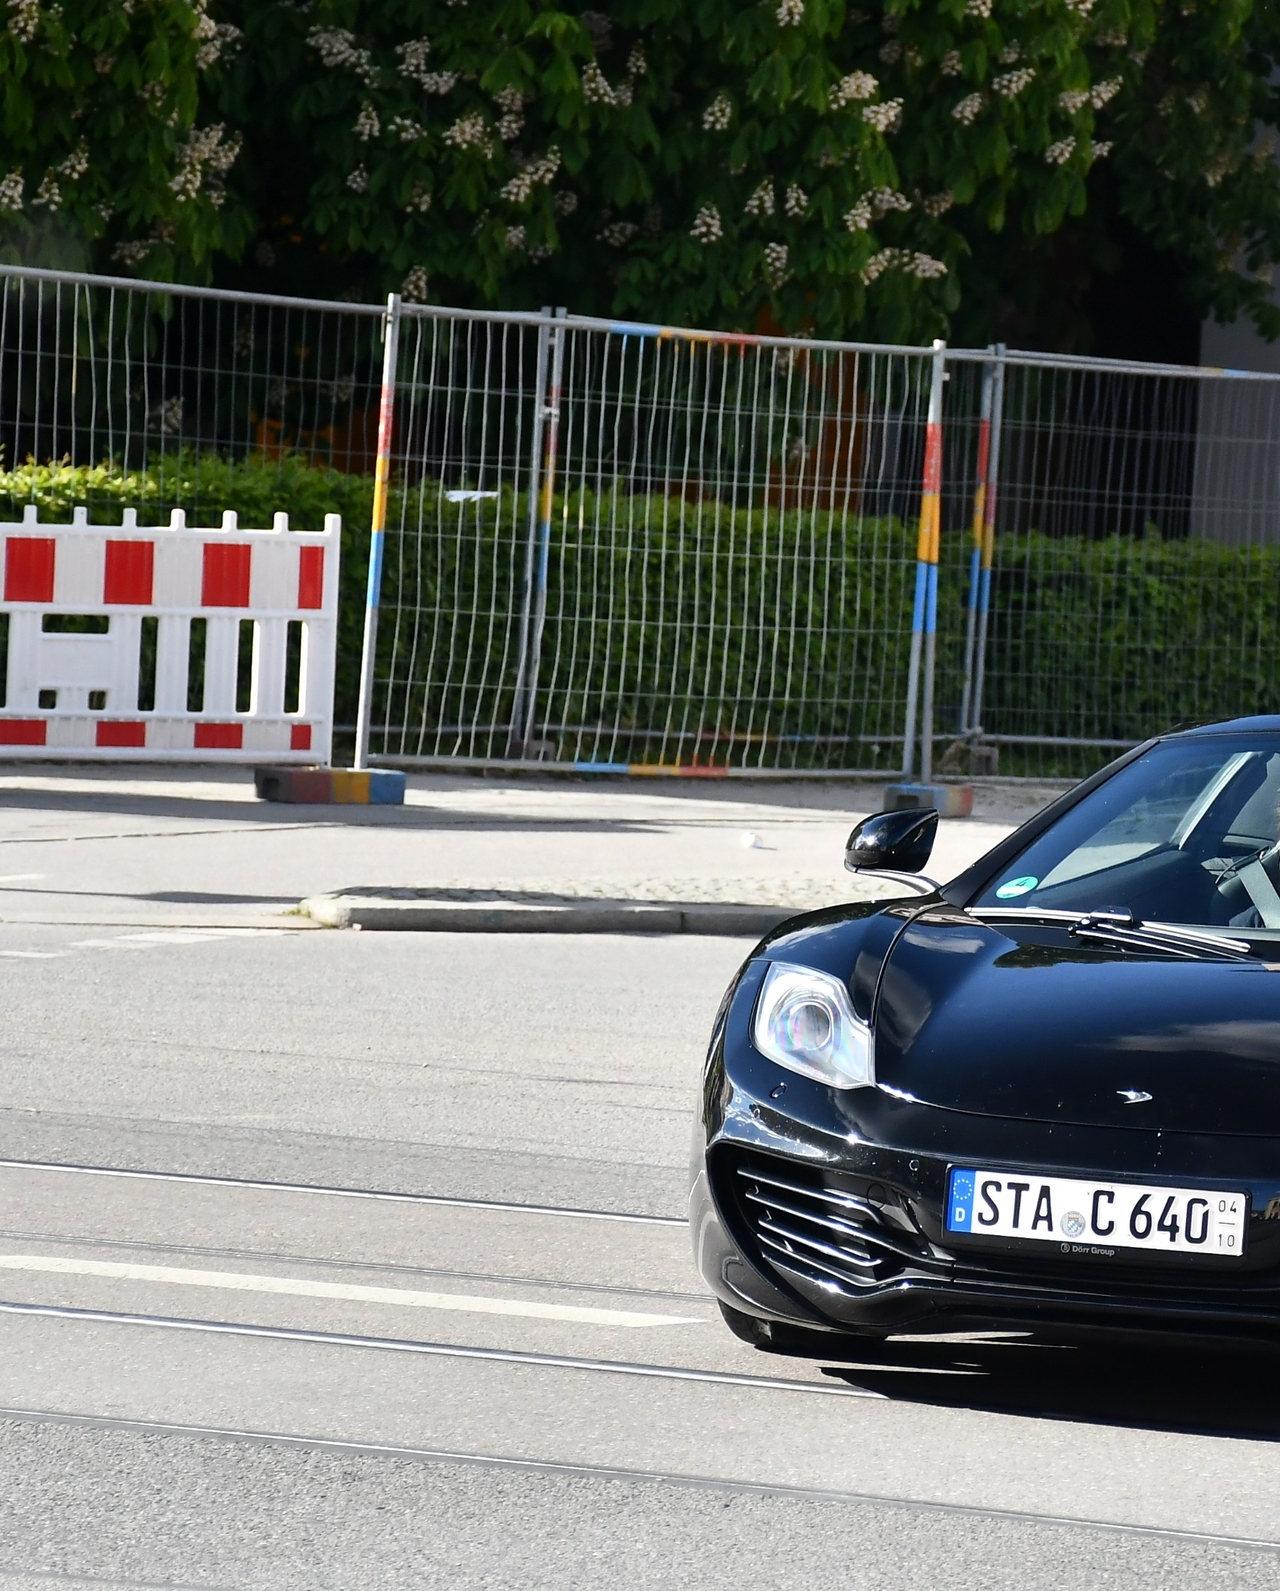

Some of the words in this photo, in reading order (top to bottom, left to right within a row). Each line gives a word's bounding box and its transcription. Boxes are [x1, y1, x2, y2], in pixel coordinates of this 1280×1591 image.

[978, 1180, 1053, 1232] STA
[1091, 1190, 1115, 1236] C
[1129, 1193, 1209, 1244] 640
[1217, 1199, 1238, 1214] 04
[954, 1207, 966, 1222] D
[1217, 1233, 1235, 1248] 10
[1072, 1245, 1089, 1253] Dörr
[1091, 1246, 1115, 1257] Group
